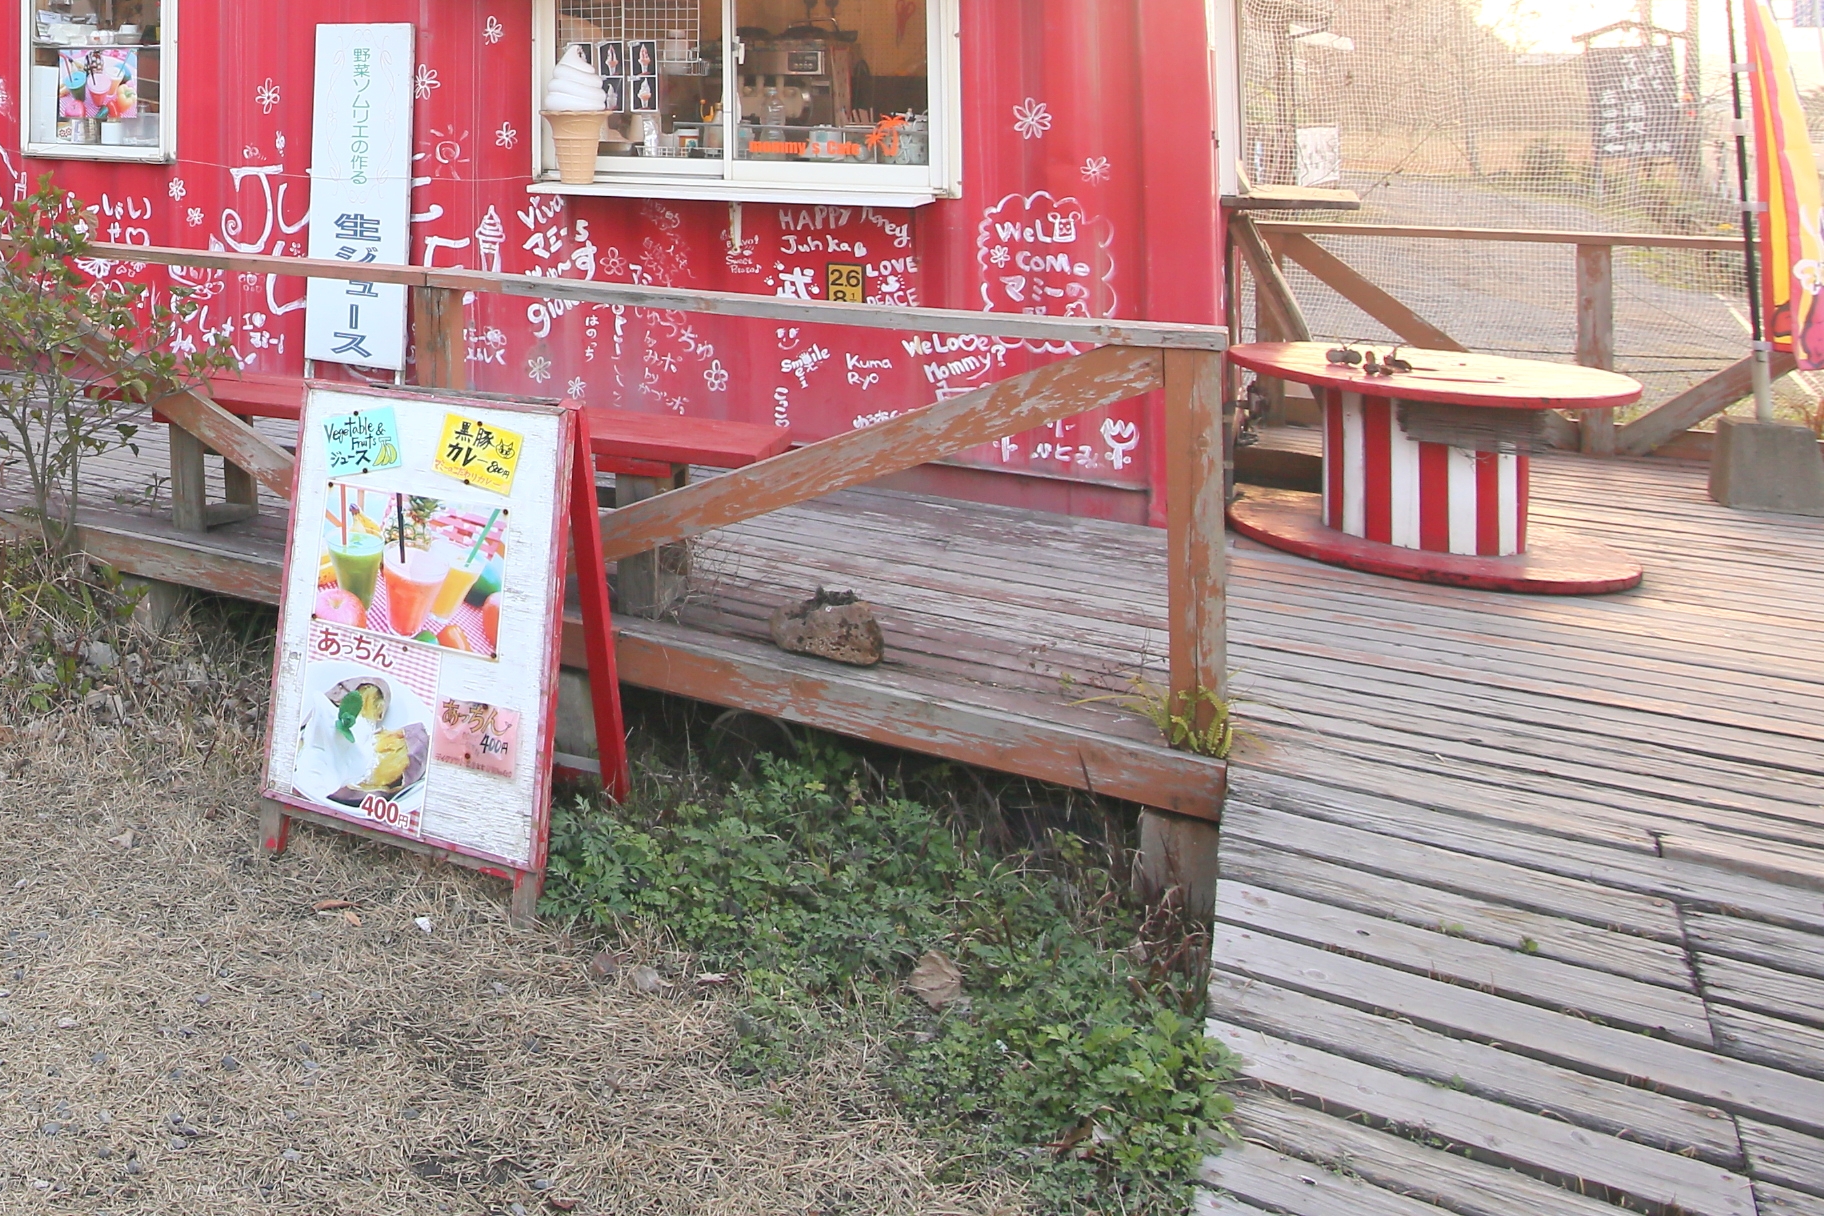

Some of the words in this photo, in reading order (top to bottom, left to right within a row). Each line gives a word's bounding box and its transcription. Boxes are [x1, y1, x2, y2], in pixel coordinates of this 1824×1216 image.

[350, 47, 371, 185] 野菜ソムリエの作る
[778, 205, 852, 231] HAPPY
[830, 268, 861, 288] 2.6
[865, 255, 919, 278] LOVE
[845, 352, 893, 370] Kuma
[323, 416, 375, 444] Vegetable
[454, 420, 496, 451] 黒豚
[330, 449, 372, 468] ジュース
[445, 441, 489, 468] カレー
[317, 627, 394, 669] あっちん
[479, 733, 509, 756] 400円
[360, 794, 410, 829] 400円
